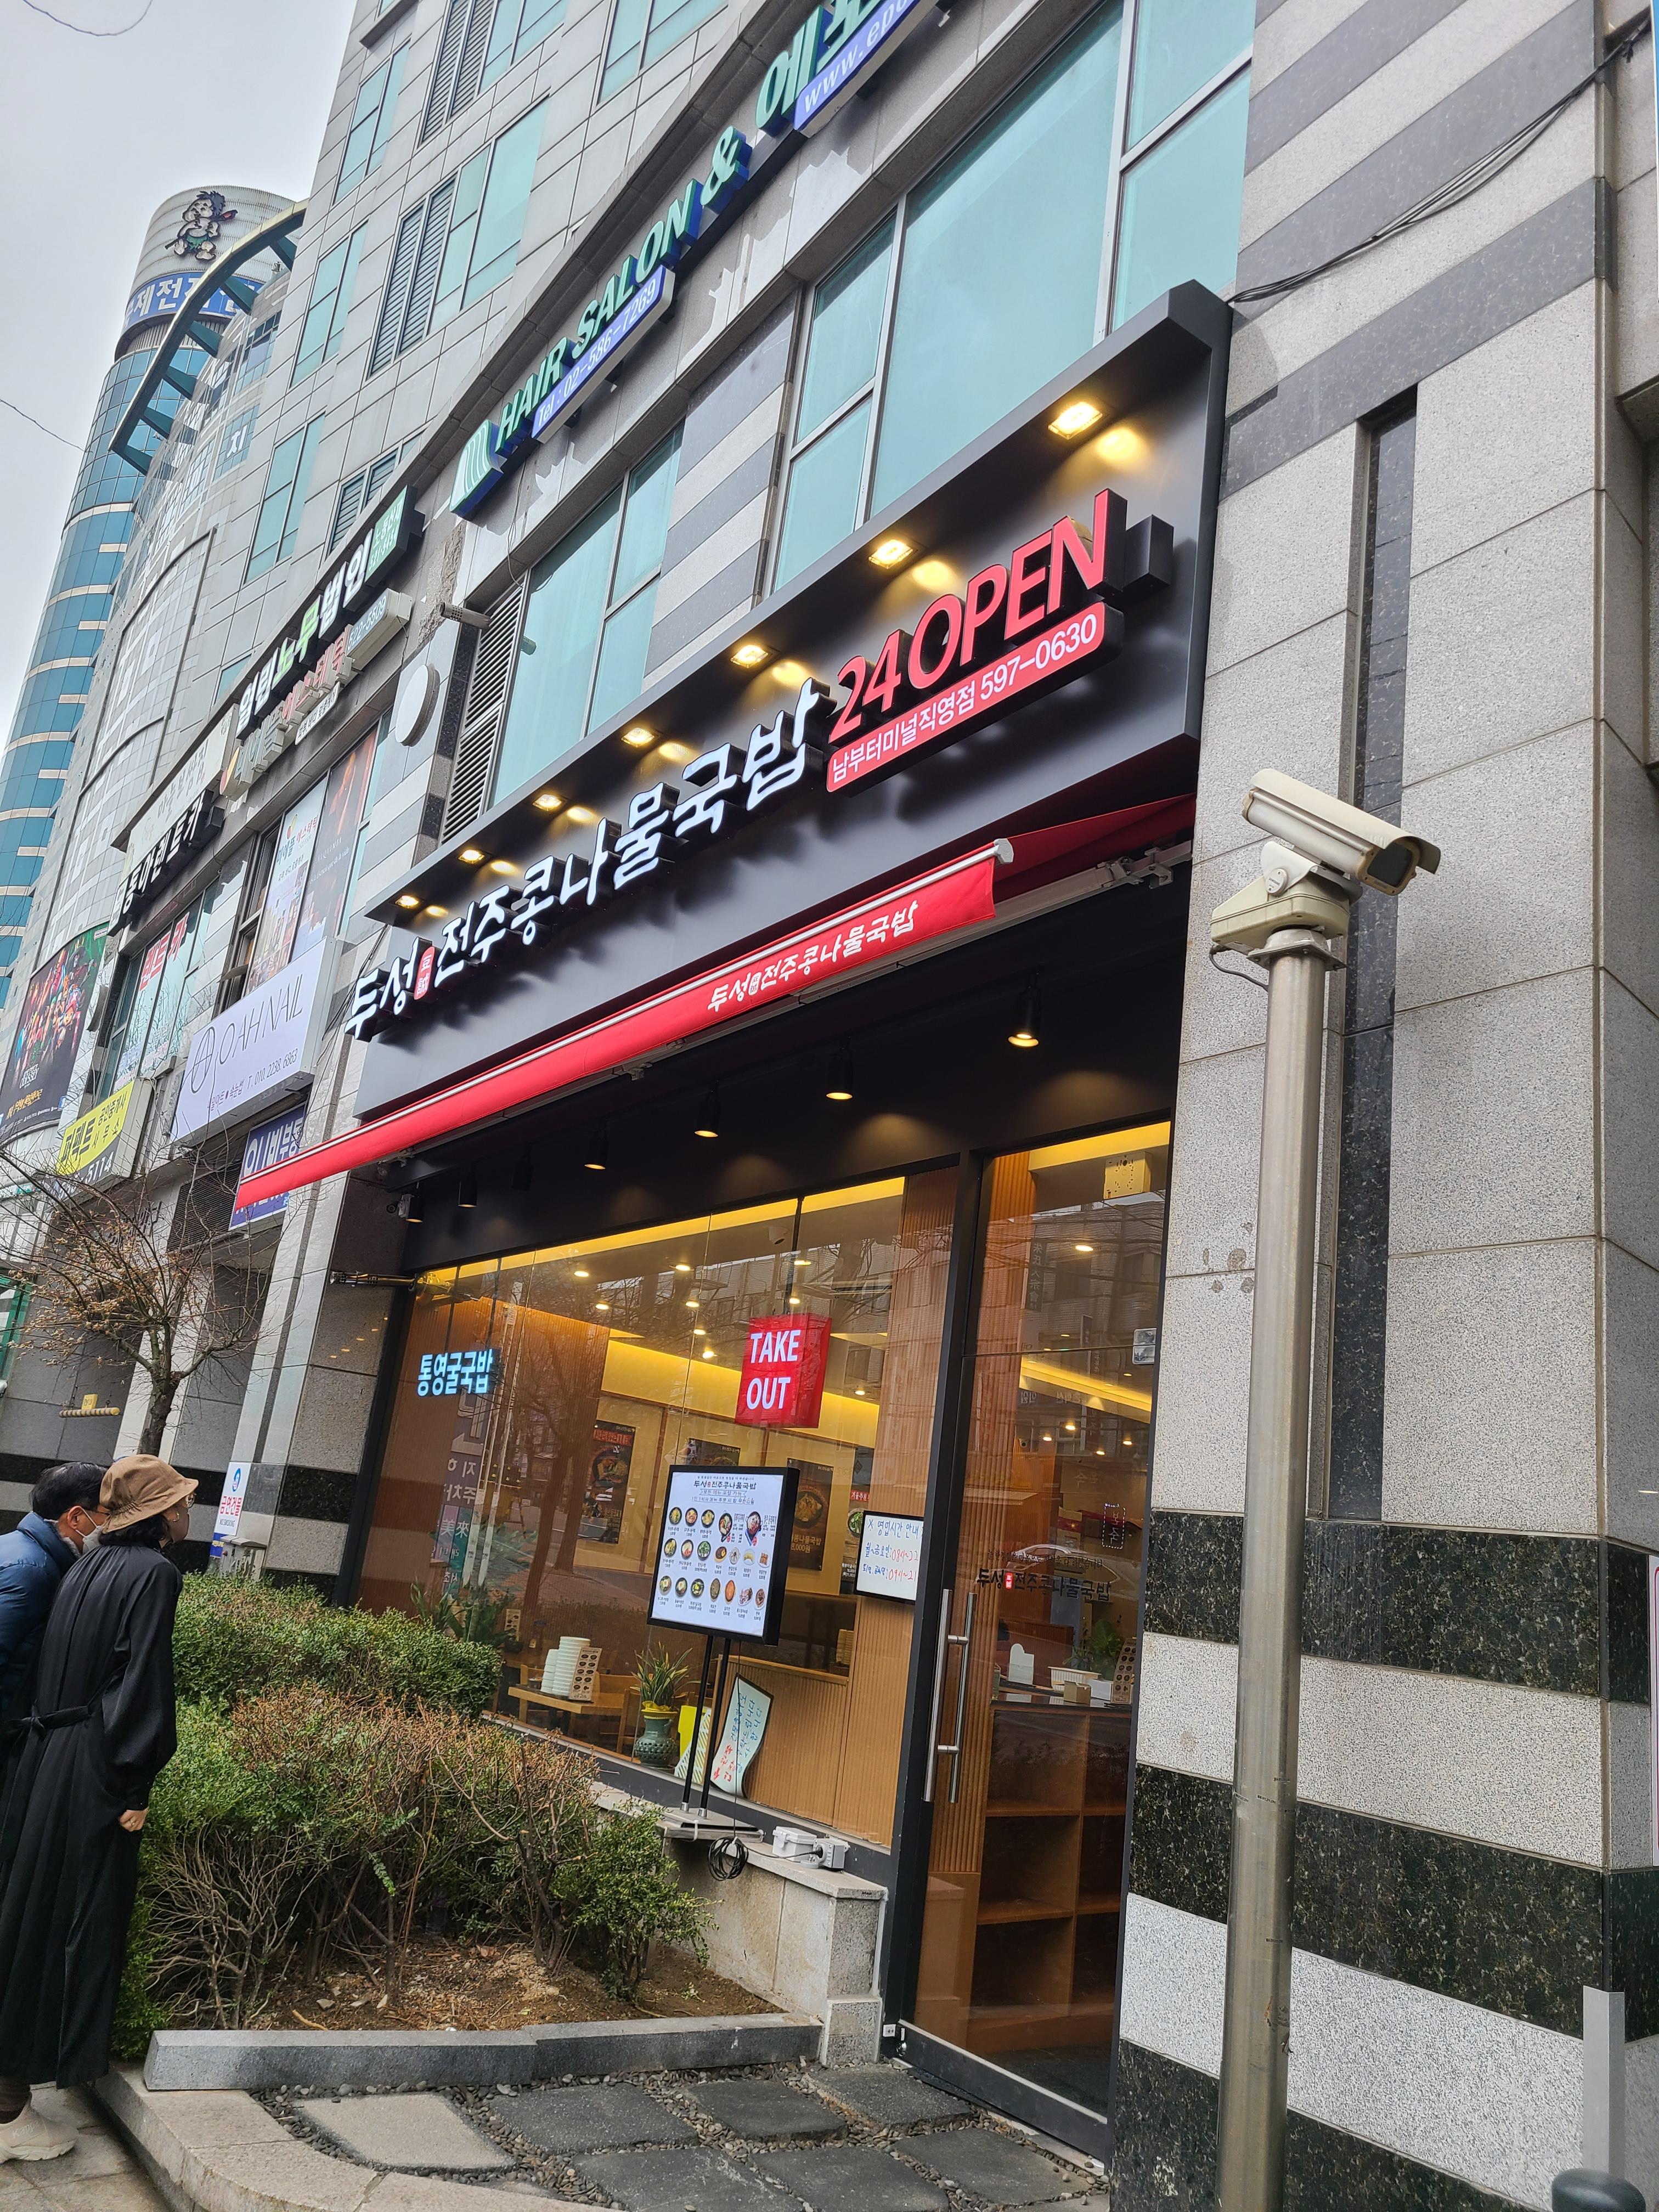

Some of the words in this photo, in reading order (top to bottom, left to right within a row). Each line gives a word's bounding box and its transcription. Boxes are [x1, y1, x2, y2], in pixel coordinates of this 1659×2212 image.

[495, 337, 568, 452] HAIR
[572, 178, 697, 359] SALON
[700, 126, 742, 206] &
[538, 394, 556, 427] Tel
[564, 278, 656, 396] 02-586-7269
[348, 594, 386, 651] 522-5509
[832, 681, 975, 783] 남부터미널직영점
[981, 613, 1096, 700] 597-0630
[123, 792, 204, 915] 동아렌트카
[345, 936, 419, 1038] 두성
[434, 678, 817, 988] 전주콩나물국밥
[707, 973, 751, 1012] 두성
[760, 901, 918, 991] 전주콩나물국밥
[61, 1117, 96, 1167] 퍼펙트
[417, 1348, 493, 1396] 통영굴국밥
[751, 1329, 800, 1363] TAKE
[747, 1376, 791, 1409] OUT
[791, 1534, 821, 1545] 콩나물국밥
[877, 1520, 903, 1538] 영업시간
[906, 1523, 919, 1539] 안내
